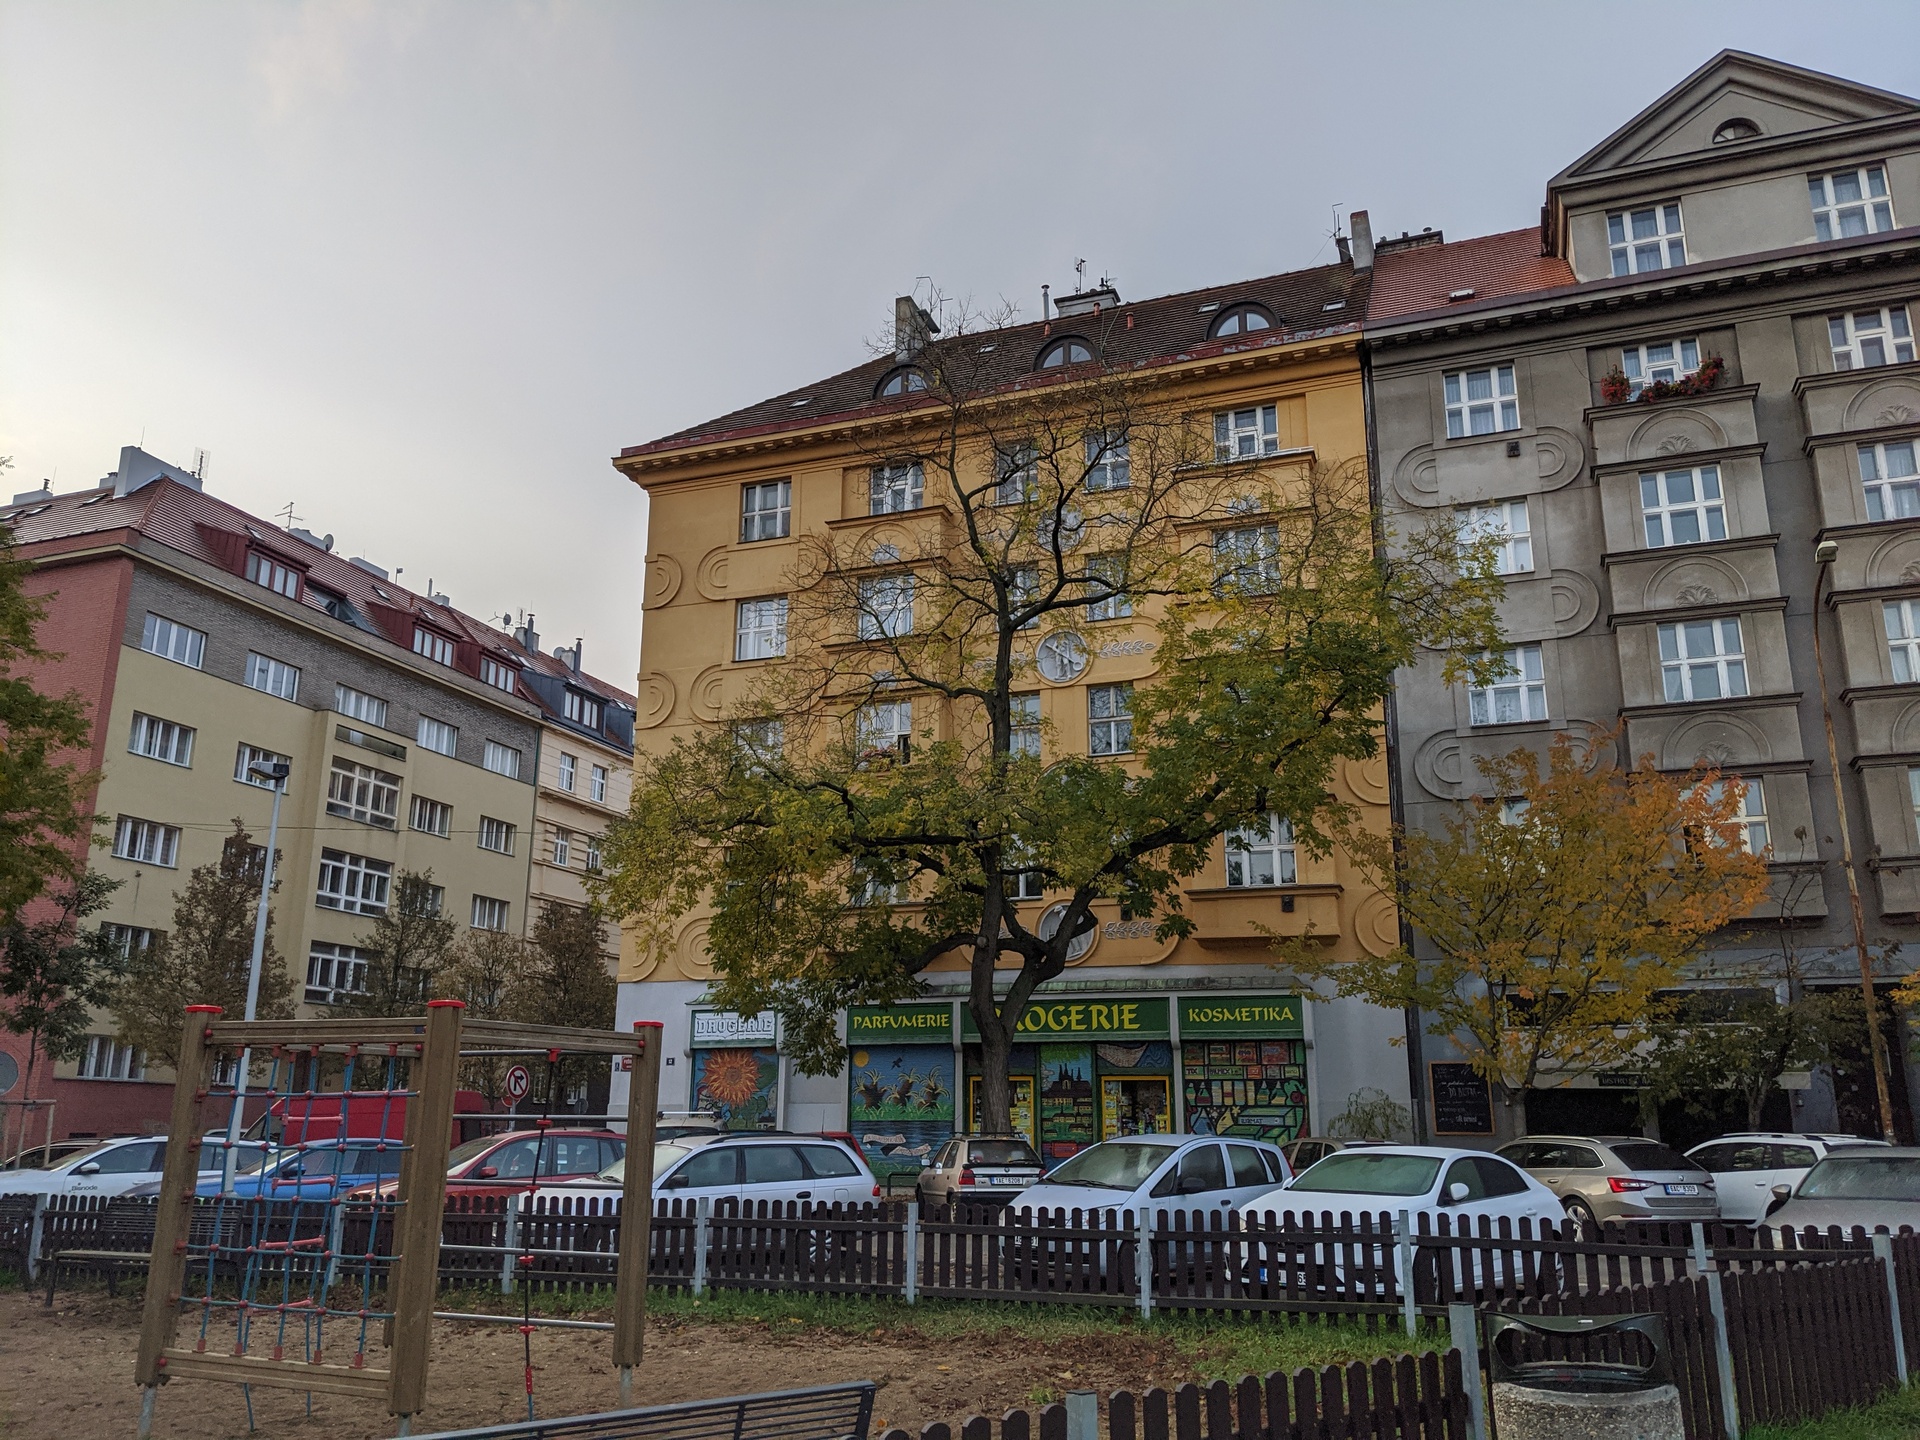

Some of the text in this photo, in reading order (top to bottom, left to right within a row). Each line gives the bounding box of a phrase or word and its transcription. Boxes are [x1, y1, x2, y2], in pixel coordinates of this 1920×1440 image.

[853, 1013, 950, 1030] PARFUMERIE
[995, 1004, 1141, 1031] OGERIE
[1188, 1006, 1295, 1023] KOSMETIKA
[697, 1018, 772, 1034] DROGERIE
